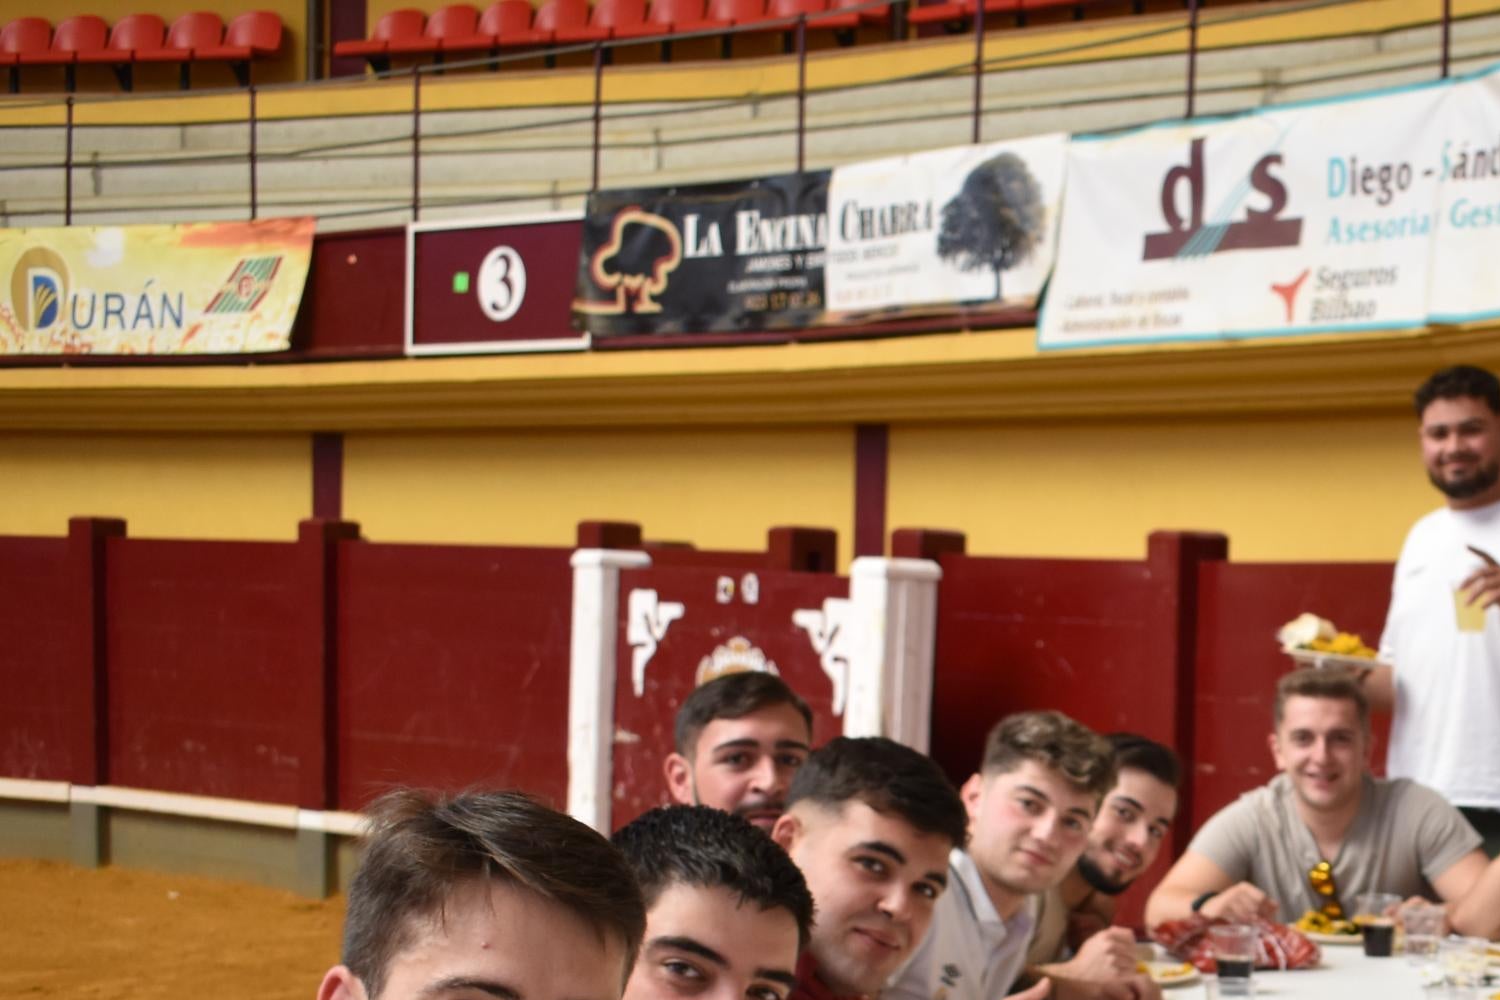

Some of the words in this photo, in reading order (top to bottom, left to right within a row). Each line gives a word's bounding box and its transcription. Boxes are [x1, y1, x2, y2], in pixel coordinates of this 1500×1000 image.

[1327, 156, 1413, 207] Diego
[487, 253, 516, 314] 3
[1314, 265, 1399, 296] Seguros
[1309, 292, 1377, 322] Bilbao
